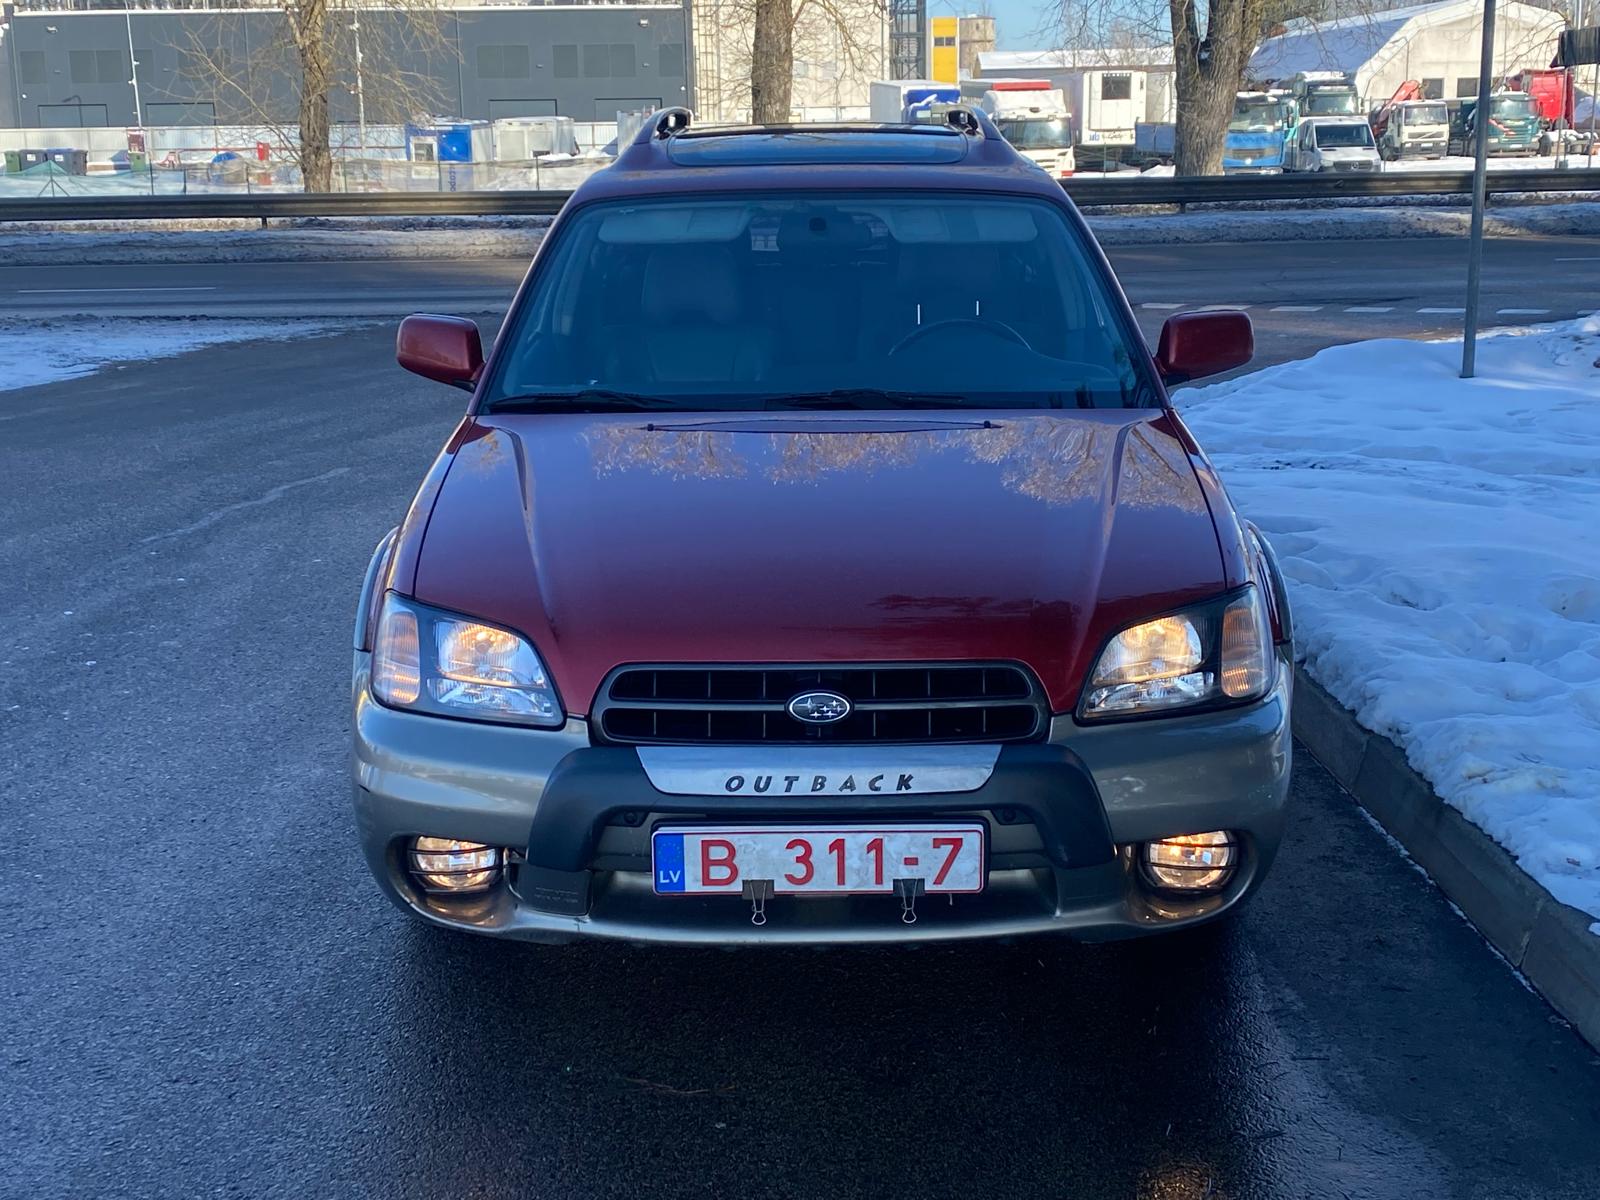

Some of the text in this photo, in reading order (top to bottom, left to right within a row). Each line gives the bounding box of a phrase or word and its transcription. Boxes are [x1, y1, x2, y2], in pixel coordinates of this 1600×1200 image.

[725, 774, 914, 793] OUTBACK
[701, 838, 963, 887] B 311-7
[659, 870, 681, 884] LV
